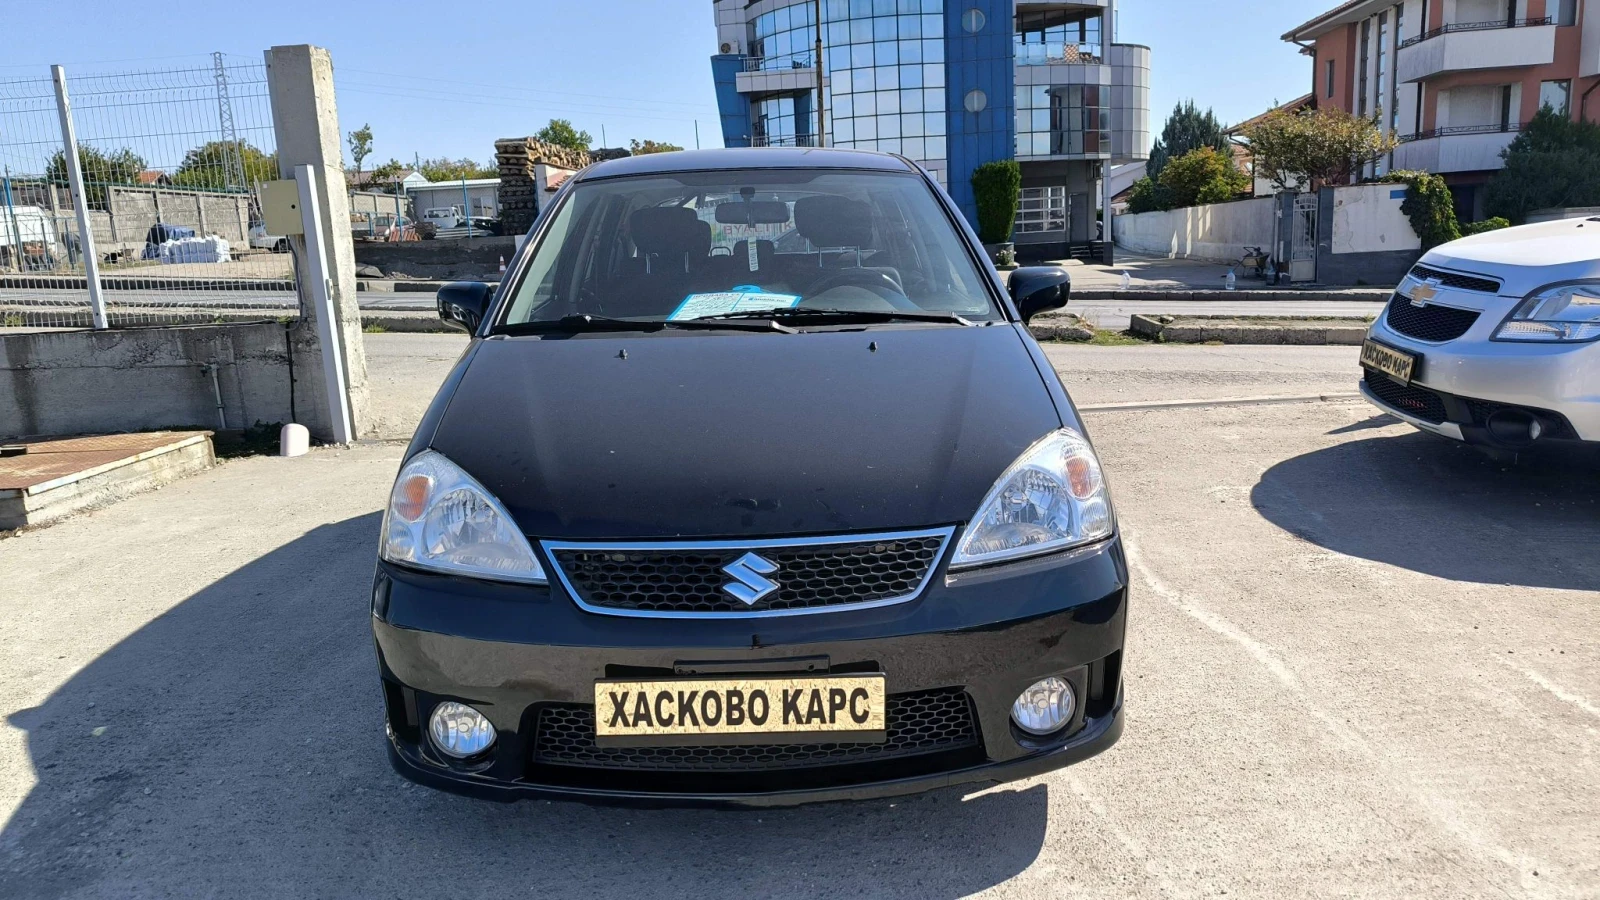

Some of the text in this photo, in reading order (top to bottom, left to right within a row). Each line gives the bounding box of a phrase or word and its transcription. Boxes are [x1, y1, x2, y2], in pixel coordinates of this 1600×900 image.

[1363, 343, 1410, 378] ХАСКОВО КАРС
[609, 687, 870, 727] ХАСКОВО КАРС
